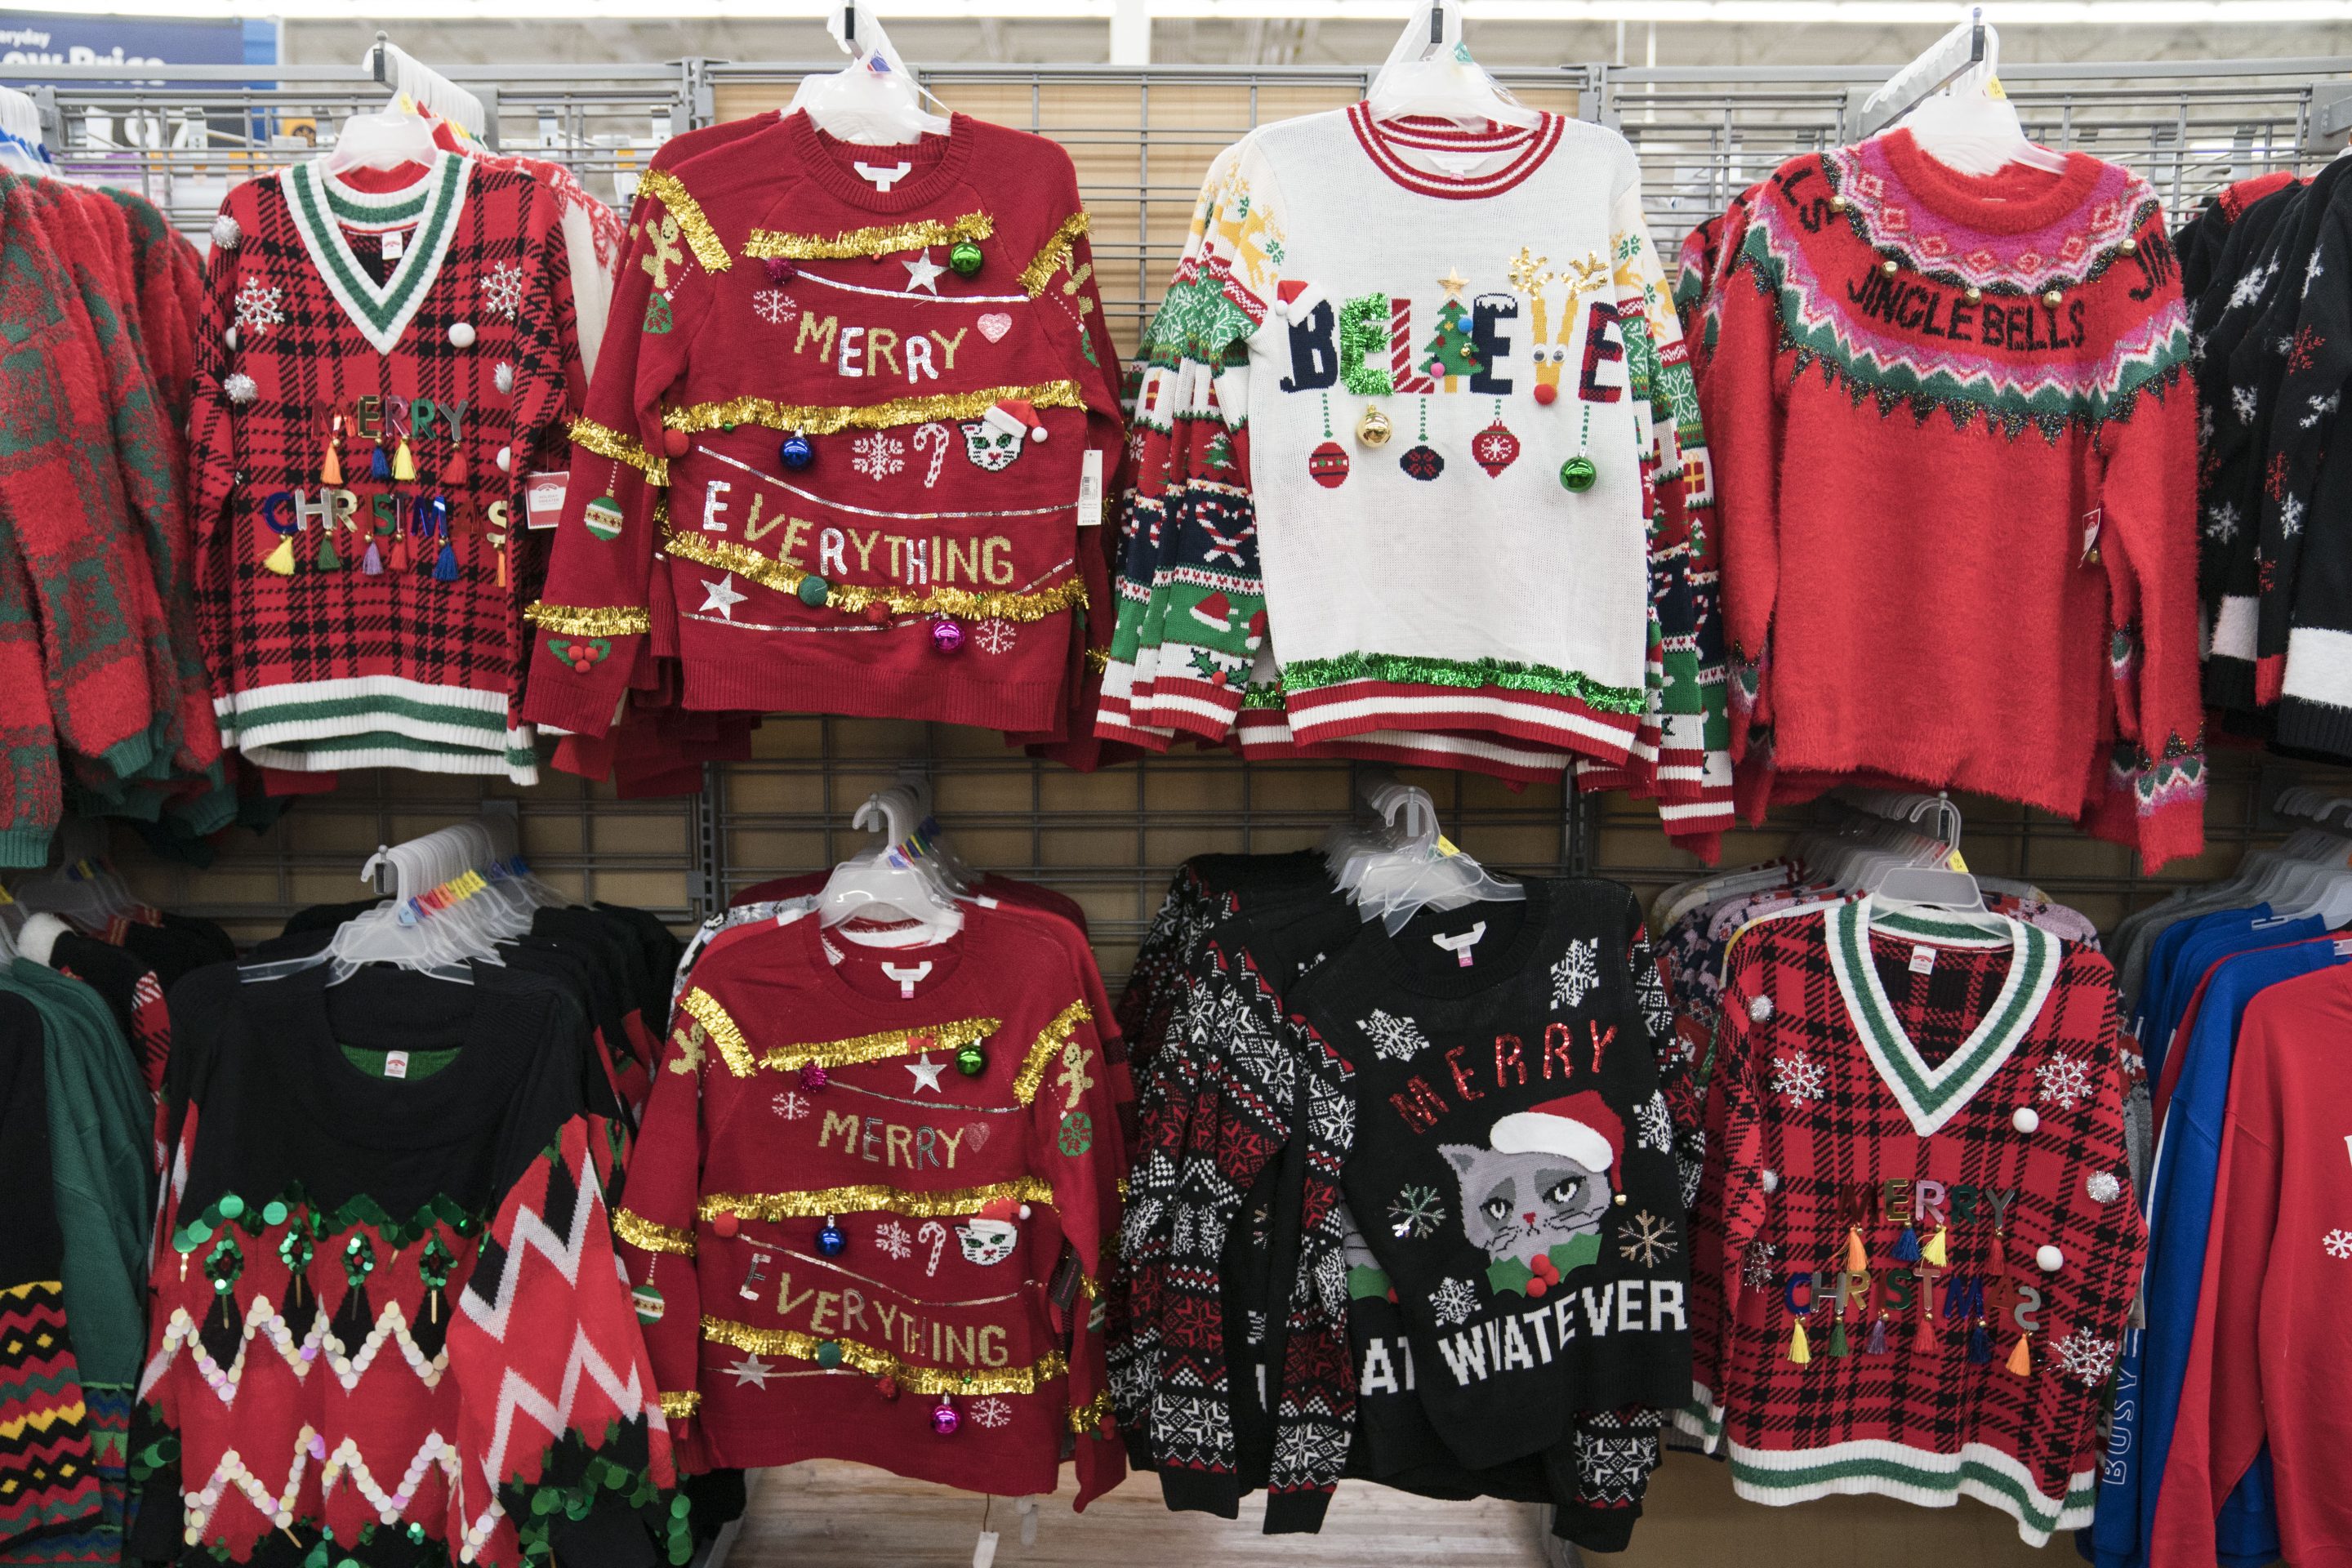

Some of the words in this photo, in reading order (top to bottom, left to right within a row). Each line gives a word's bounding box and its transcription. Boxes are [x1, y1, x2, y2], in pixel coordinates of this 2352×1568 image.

[794, 310, 968, 385] MERRY
[1846, 264, 1973, 341] JINGLE
[1981, 299, 2085, 351] BELLS
[311, 394, 470, 442] MERRY
[702, 480, 1014, 586] EVERYTHING
[1389, 1019, 1619, 1135] MERRY
[817, 1110, 964, 1170] MERRY
[1838, 1178, 2016, 1227] MERRY
[739, 1254, 1009, 1368] EVERYTHING
[1784, 1267, 2042, 1331] CHRISTMAS
[2101, 1366, 2138, 1486] BUSY
